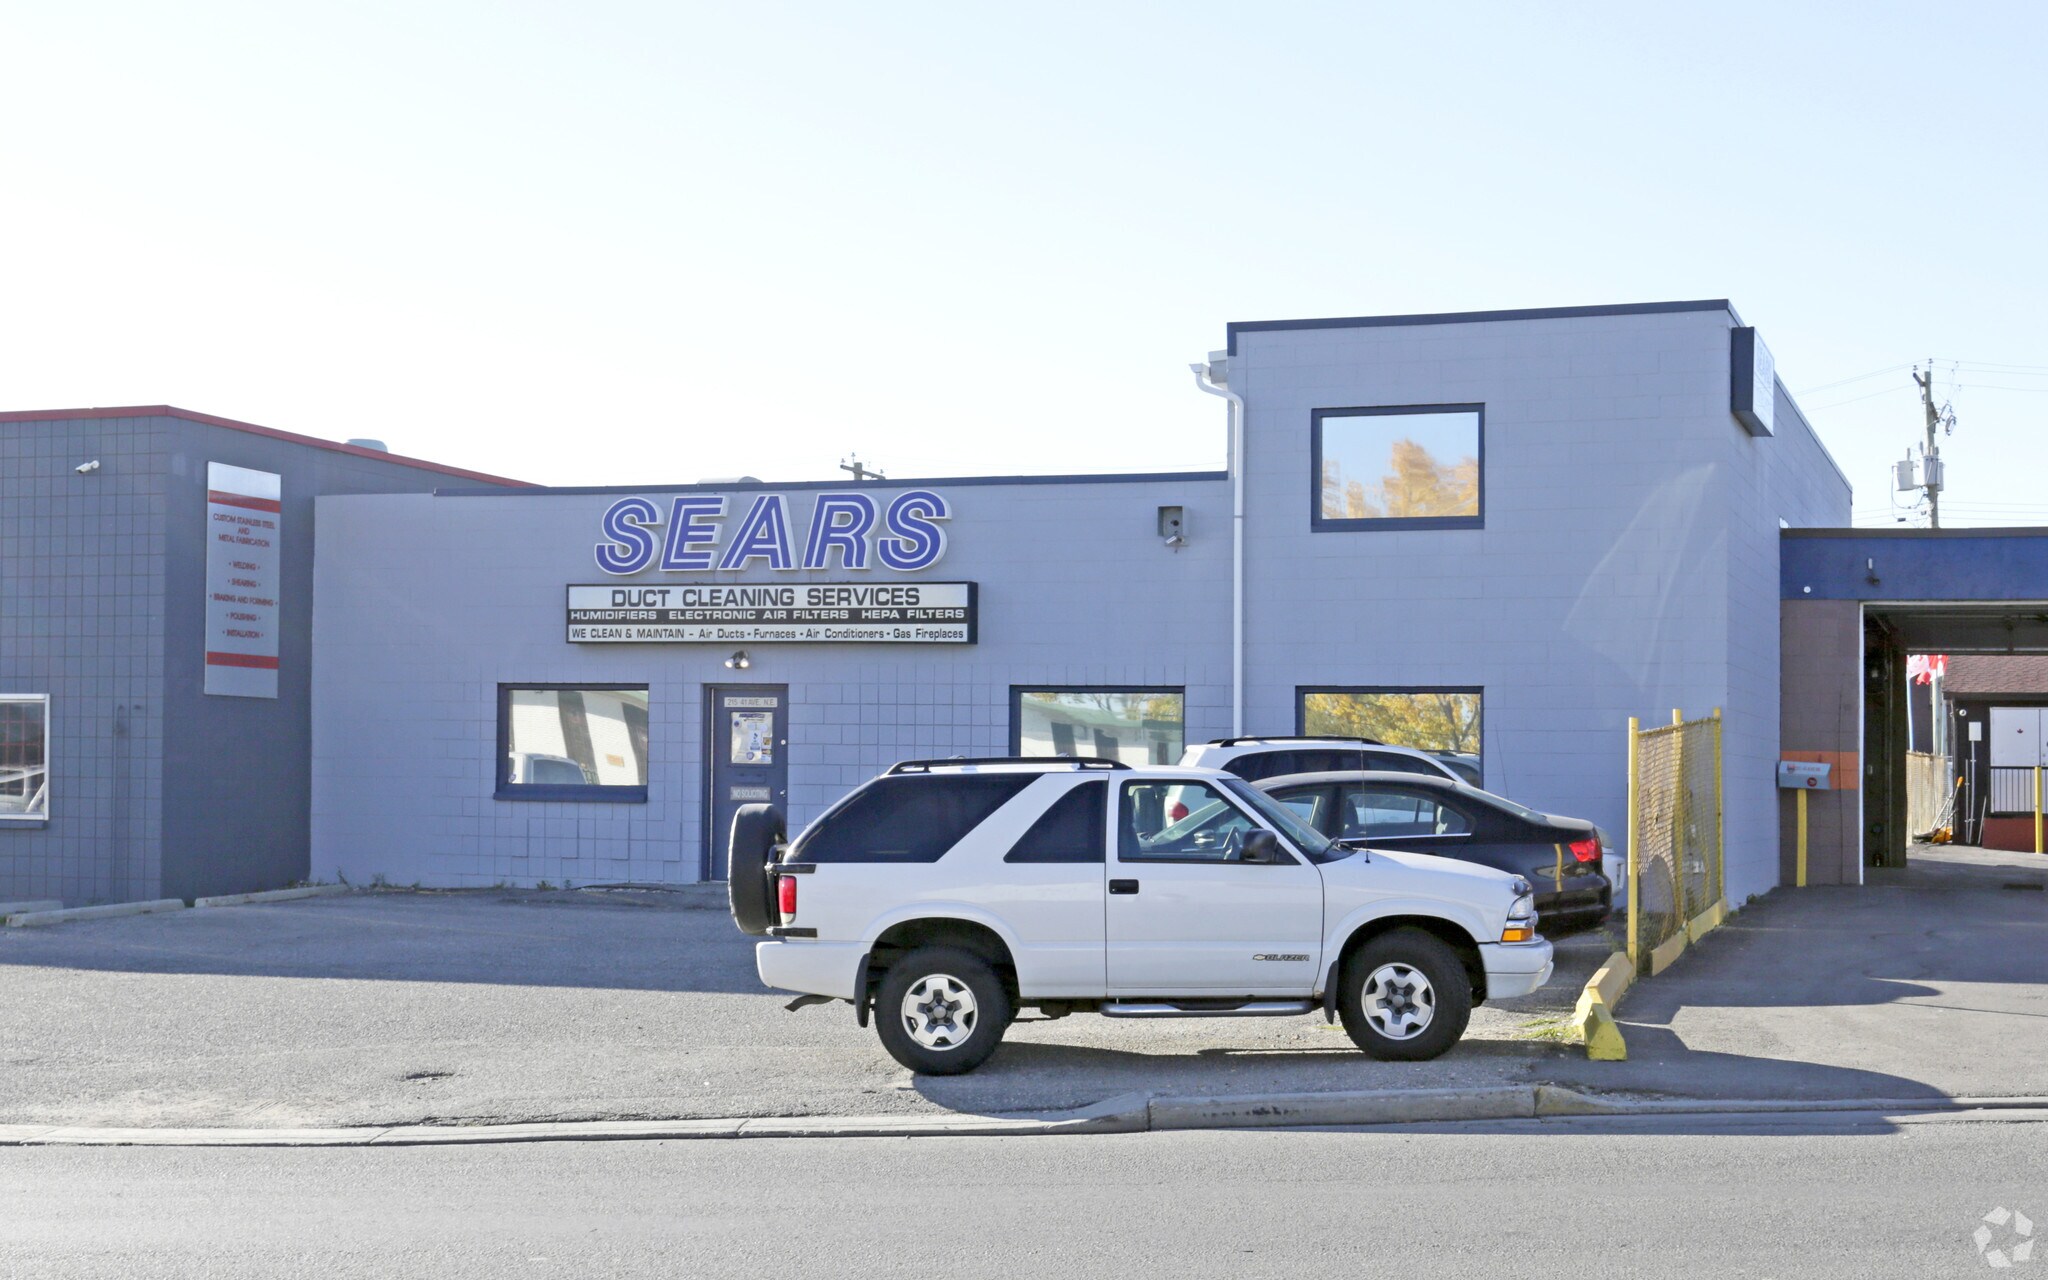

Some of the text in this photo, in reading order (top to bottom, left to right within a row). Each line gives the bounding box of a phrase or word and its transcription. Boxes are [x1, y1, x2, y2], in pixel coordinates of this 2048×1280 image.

[213, 513, 275, 529] CUSTOM STAINLESS STEEL
[238, 527, 249, 535] AND
[594, 490, 952, 576] SEARS
[218, 533, 270, 547] METAL FABRICATION
[237, 596, 248, 604] AND
[612, 587, 920, 607] DUCT CLEANING SERVICES
[570, 609, 965, 620] HUMIDIFIERS ELECTRONIC AIR FILTERS HEPA FILTERS
[227, 629, 260, 638] INSTALLATION
[572, 628, 586, 638] WE
[590, 628, 622, 638] CLEAN
[625, 629, 632, 638] &
[636, 628, 685, 638] MAINTAIN
[699, 628, 713, 638] Air
[717, 628, 745, 638] Ducts
[753, 628, 796, 638] Furnaces
[806, 628, 820, 638] Air
[824, 628, 884, 638] Conditioners
[893, 628, 911, 638] Gas
[915, 628, 964, 641] Fireplaces
[732, 789, 768, 798] NO SOLICITING
